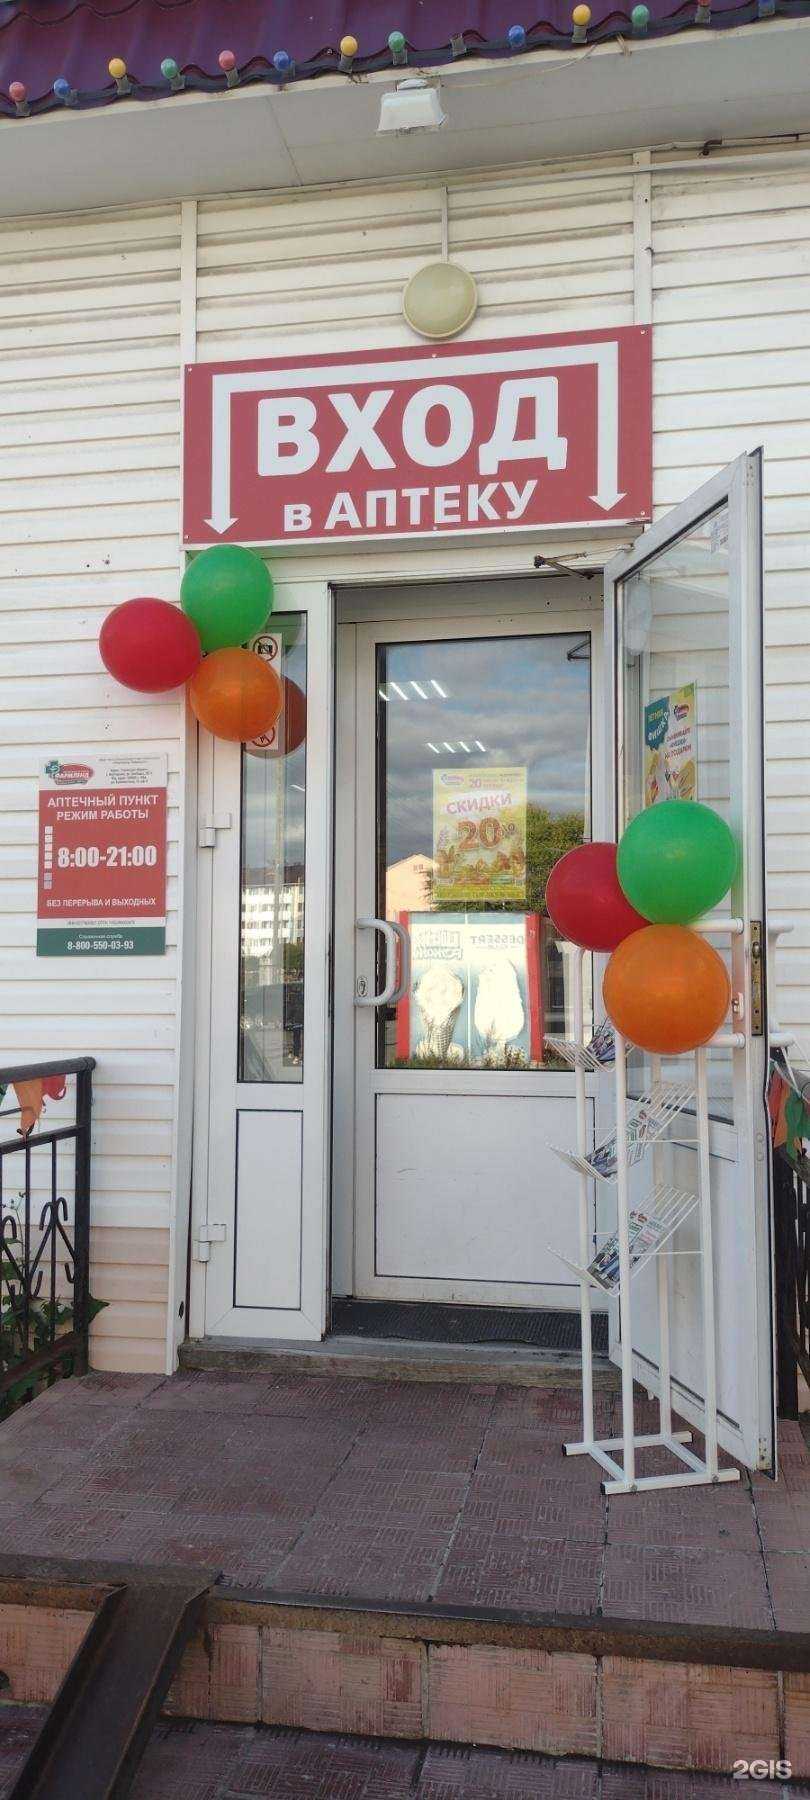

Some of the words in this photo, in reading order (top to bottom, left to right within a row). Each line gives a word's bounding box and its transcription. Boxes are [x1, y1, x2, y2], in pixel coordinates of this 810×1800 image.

[256, 375, 568, 477] ВХОД
[324, 479, 539, 530] АПТЕКУ
[47, 793, 116, 808] АПТЕЧНЫЙ
[119, 795, 159, 806] ПУНКТ
[446, 793, 512, 815] СКИДКИ
[57, 811, 98, 821] РЕЖИМ
[101, 809, 149, 820] РАБОТЫ
[57, 845, 158, 868] 8:00-21:00
[46, 899, 61, 908] БЕЗ
[62, 898, 103, 907] ПЕРЕРЫВА
[104, 898, 111, 906] И
[112, 897, 156, 907] ВЫХОДНЫХ
[67, 940, 134, 951] 8-800-550-03-93
